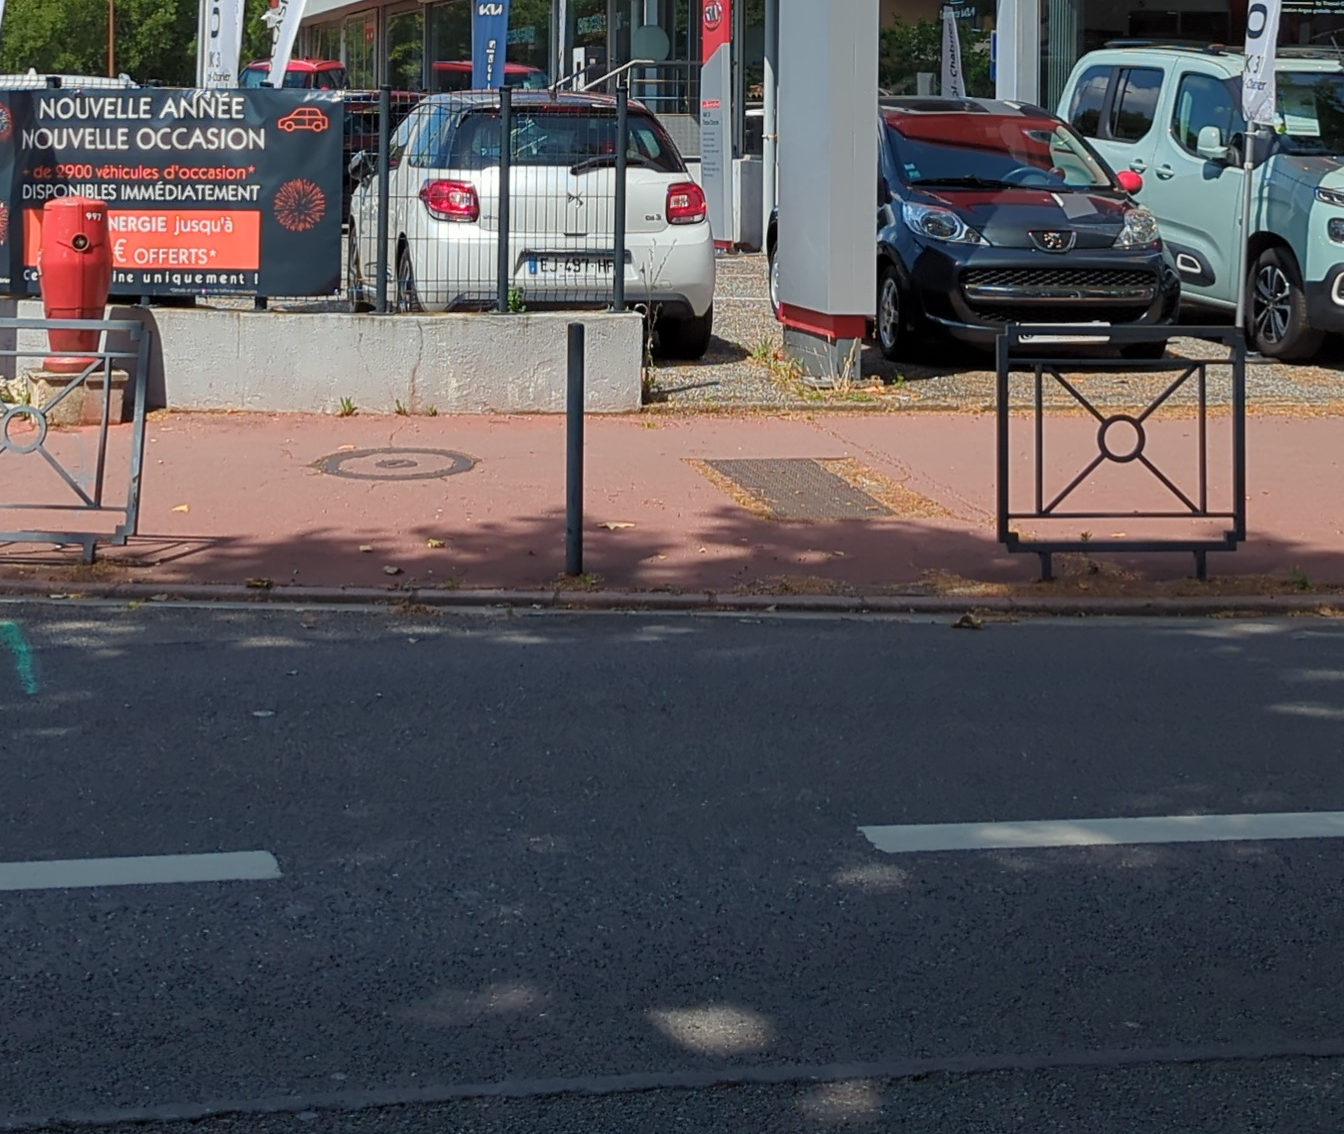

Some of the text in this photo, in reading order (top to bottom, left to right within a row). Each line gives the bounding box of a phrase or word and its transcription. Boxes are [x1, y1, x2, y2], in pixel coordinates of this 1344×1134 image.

[39, 93, 244, 120] NOUVELLE ANNÉE
[22, 128, 266, 151] NOUVELLE OCCASION
[33, 165, 52, 180] de
[56, 165, 93, 180] 2900
[95, 164, 158, 180] véhicules
[22, 181, 261, 201] DISPONIBLES IMMÉDIATEMENT
[107, 215, 234, 236] NERGIE jusqu'à
[143, 273, 245, 287] uniquement
